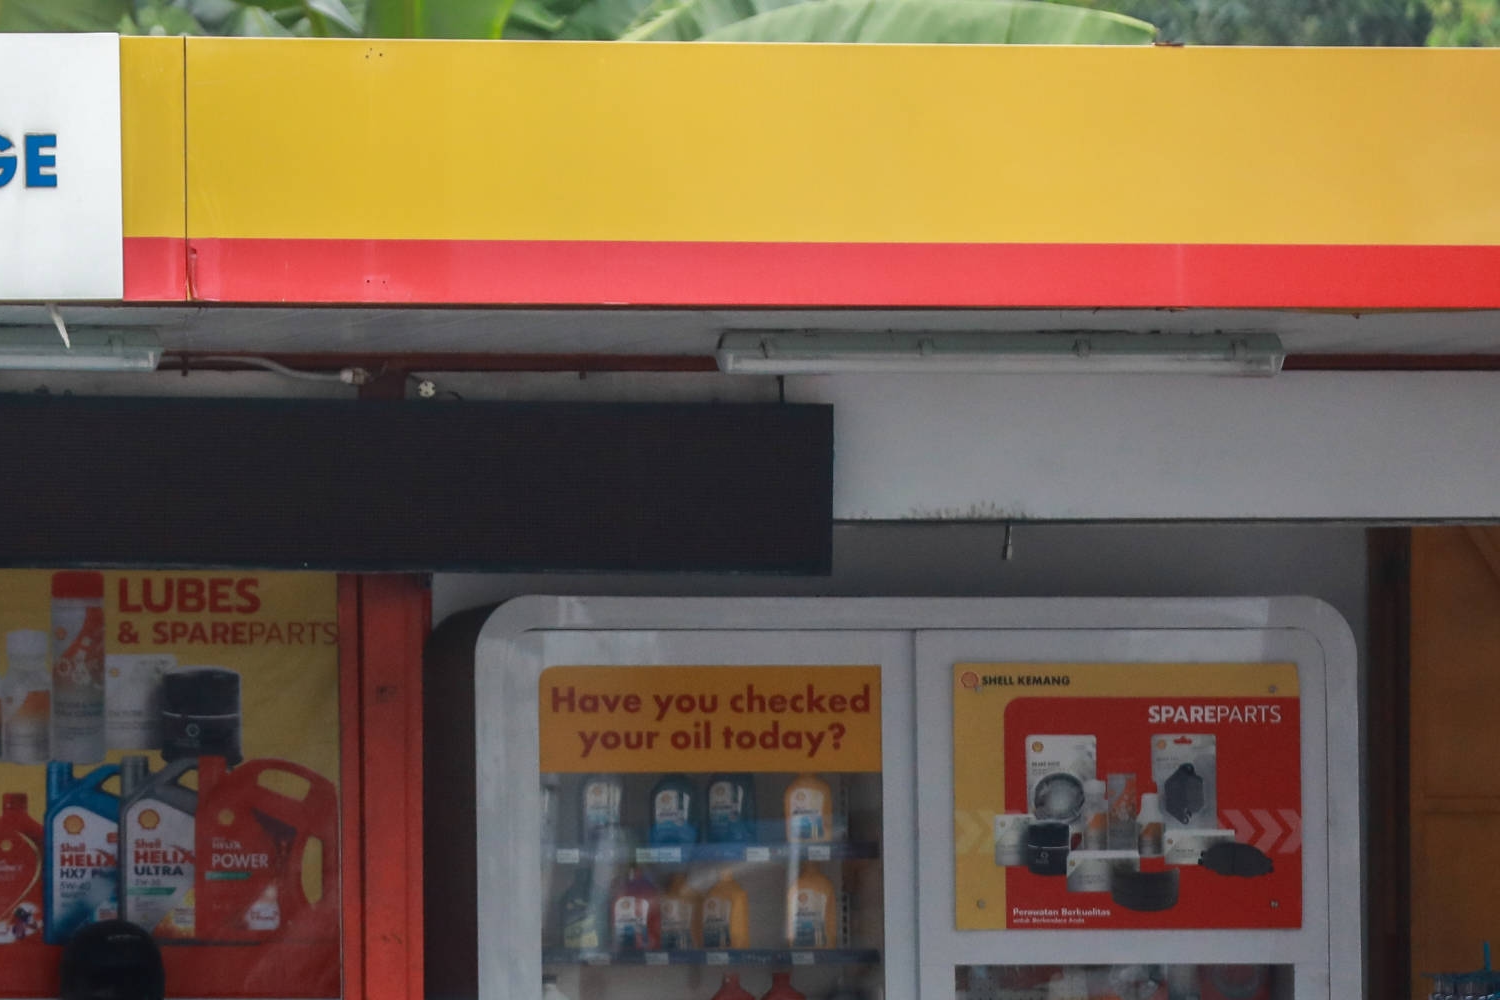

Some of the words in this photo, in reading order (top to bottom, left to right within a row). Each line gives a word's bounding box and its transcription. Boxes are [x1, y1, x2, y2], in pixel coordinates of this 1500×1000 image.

[117, 577, 262, 614] LUBES
[116, 621, 140, 645] &
[152, 621, 338, 646] SPAREPARTS
[982, 675, 1014, 687] SHELL
[1017, 675, 1070, 687] KEMANG
[551, 686, 642, 714] Have
[653, 693, 718, 721] you
[730, 684, 871, 714] checked
[1148, 705, 1282, 724] SPAREPARTS
[578, 730, 660, 758] your
[670, 720, 711, 750] oil
[722, 721, 846, 758] today?
[134, 839, 162, 849] Shell
[60, 853, 116, 867] HELIX
[134, 849, 196, 865] HELIX
[211, 853, 269, 869] POWER
[60, 868, 86, 879] HX7
[134, 865, 184, 876] ULTRA
